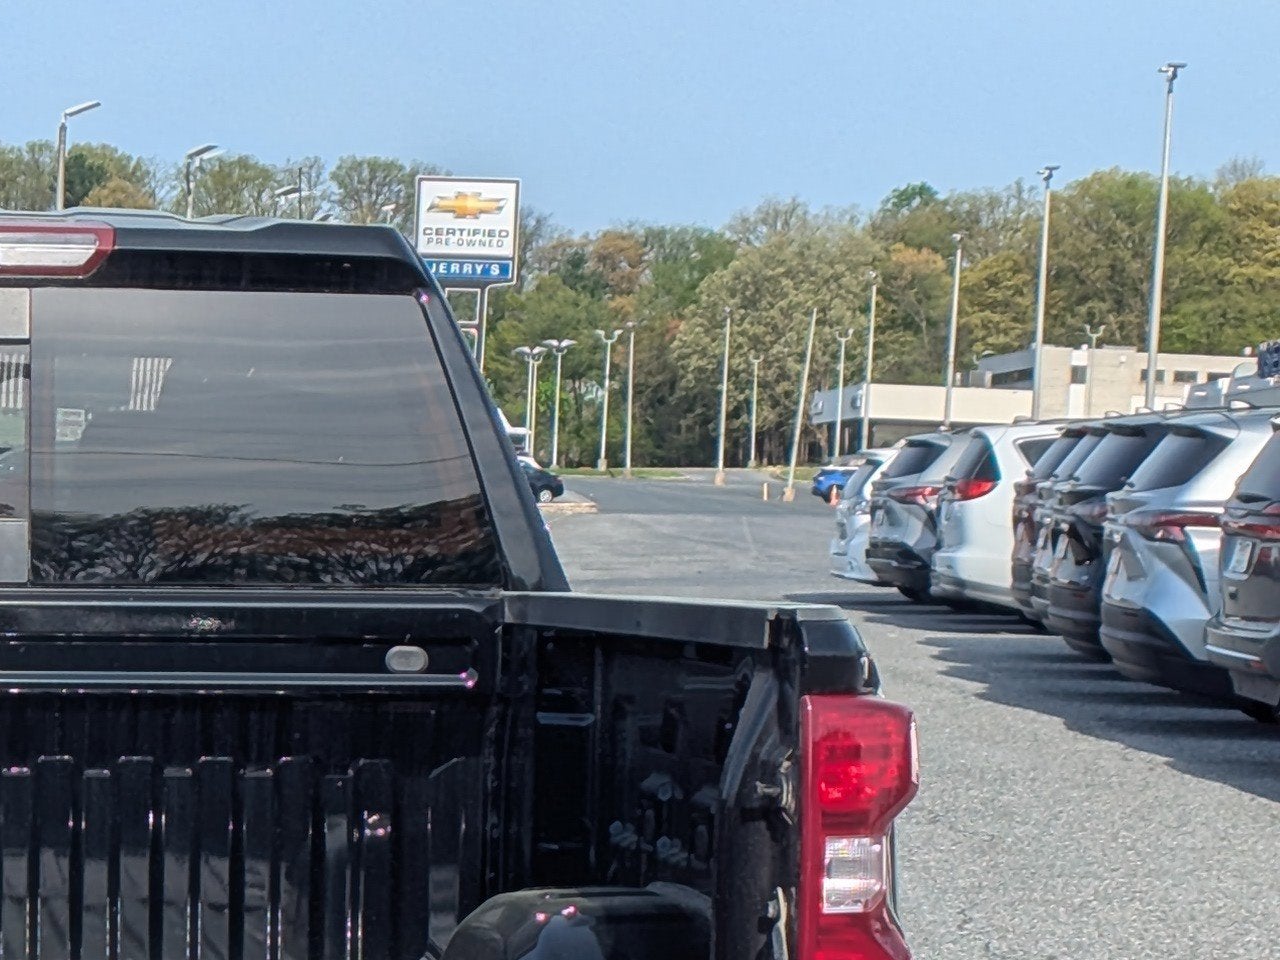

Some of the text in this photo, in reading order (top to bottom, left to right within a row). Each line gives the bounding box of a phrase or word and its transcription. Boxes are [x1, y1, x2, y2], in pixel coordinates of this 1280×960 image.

[422, 226, 510, 239] CERTIFIED
[426, 237, 504, 248] PRE-OWNED
[431, 262, 500, 276] JERRY'S
